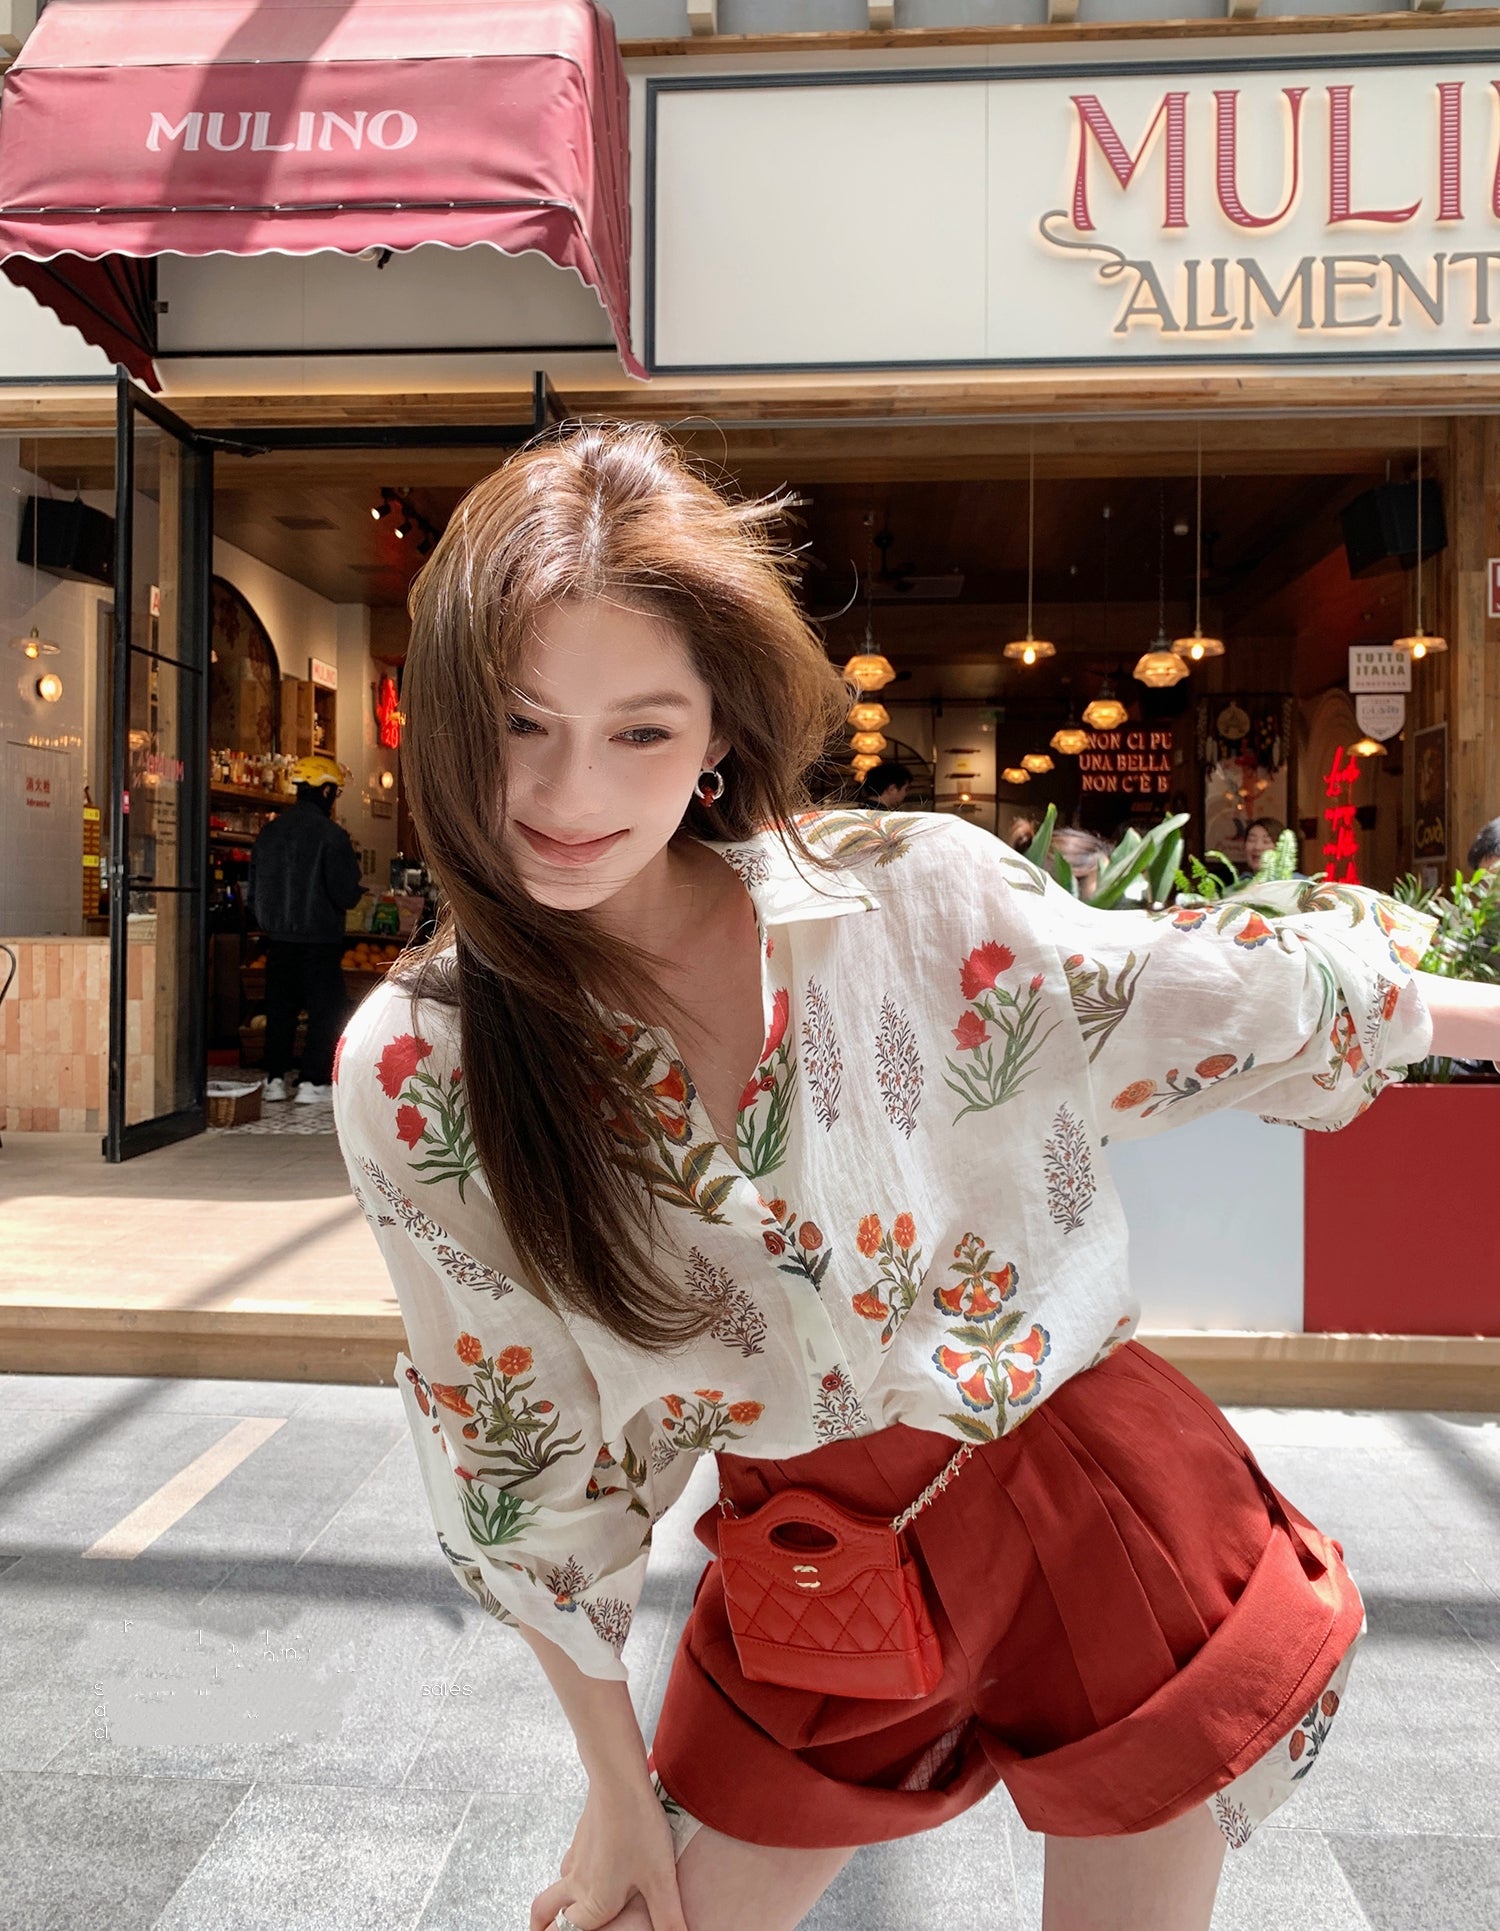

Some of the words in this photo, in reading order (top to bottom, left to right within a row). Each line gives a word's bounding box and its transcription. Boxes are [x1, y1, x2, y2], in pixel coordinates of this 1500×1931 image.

[146, 109, 418, 152] MULINO
[1069, 81, 1500, 231] MULI
[1100, 250, 1500, 333] ALIMENT
[1356, 652, 1405, 663] TUTTO
[1356, 665, 1406, 676] ITALIA
[1086, 732, 1121, 750] NON
[1127, 732, 1145, 750] CI
[1079, 754, 1114, 771] UNA
[1116, 754, 1171, 771] BELLA
[1082, 775, 1118, 793] NON
